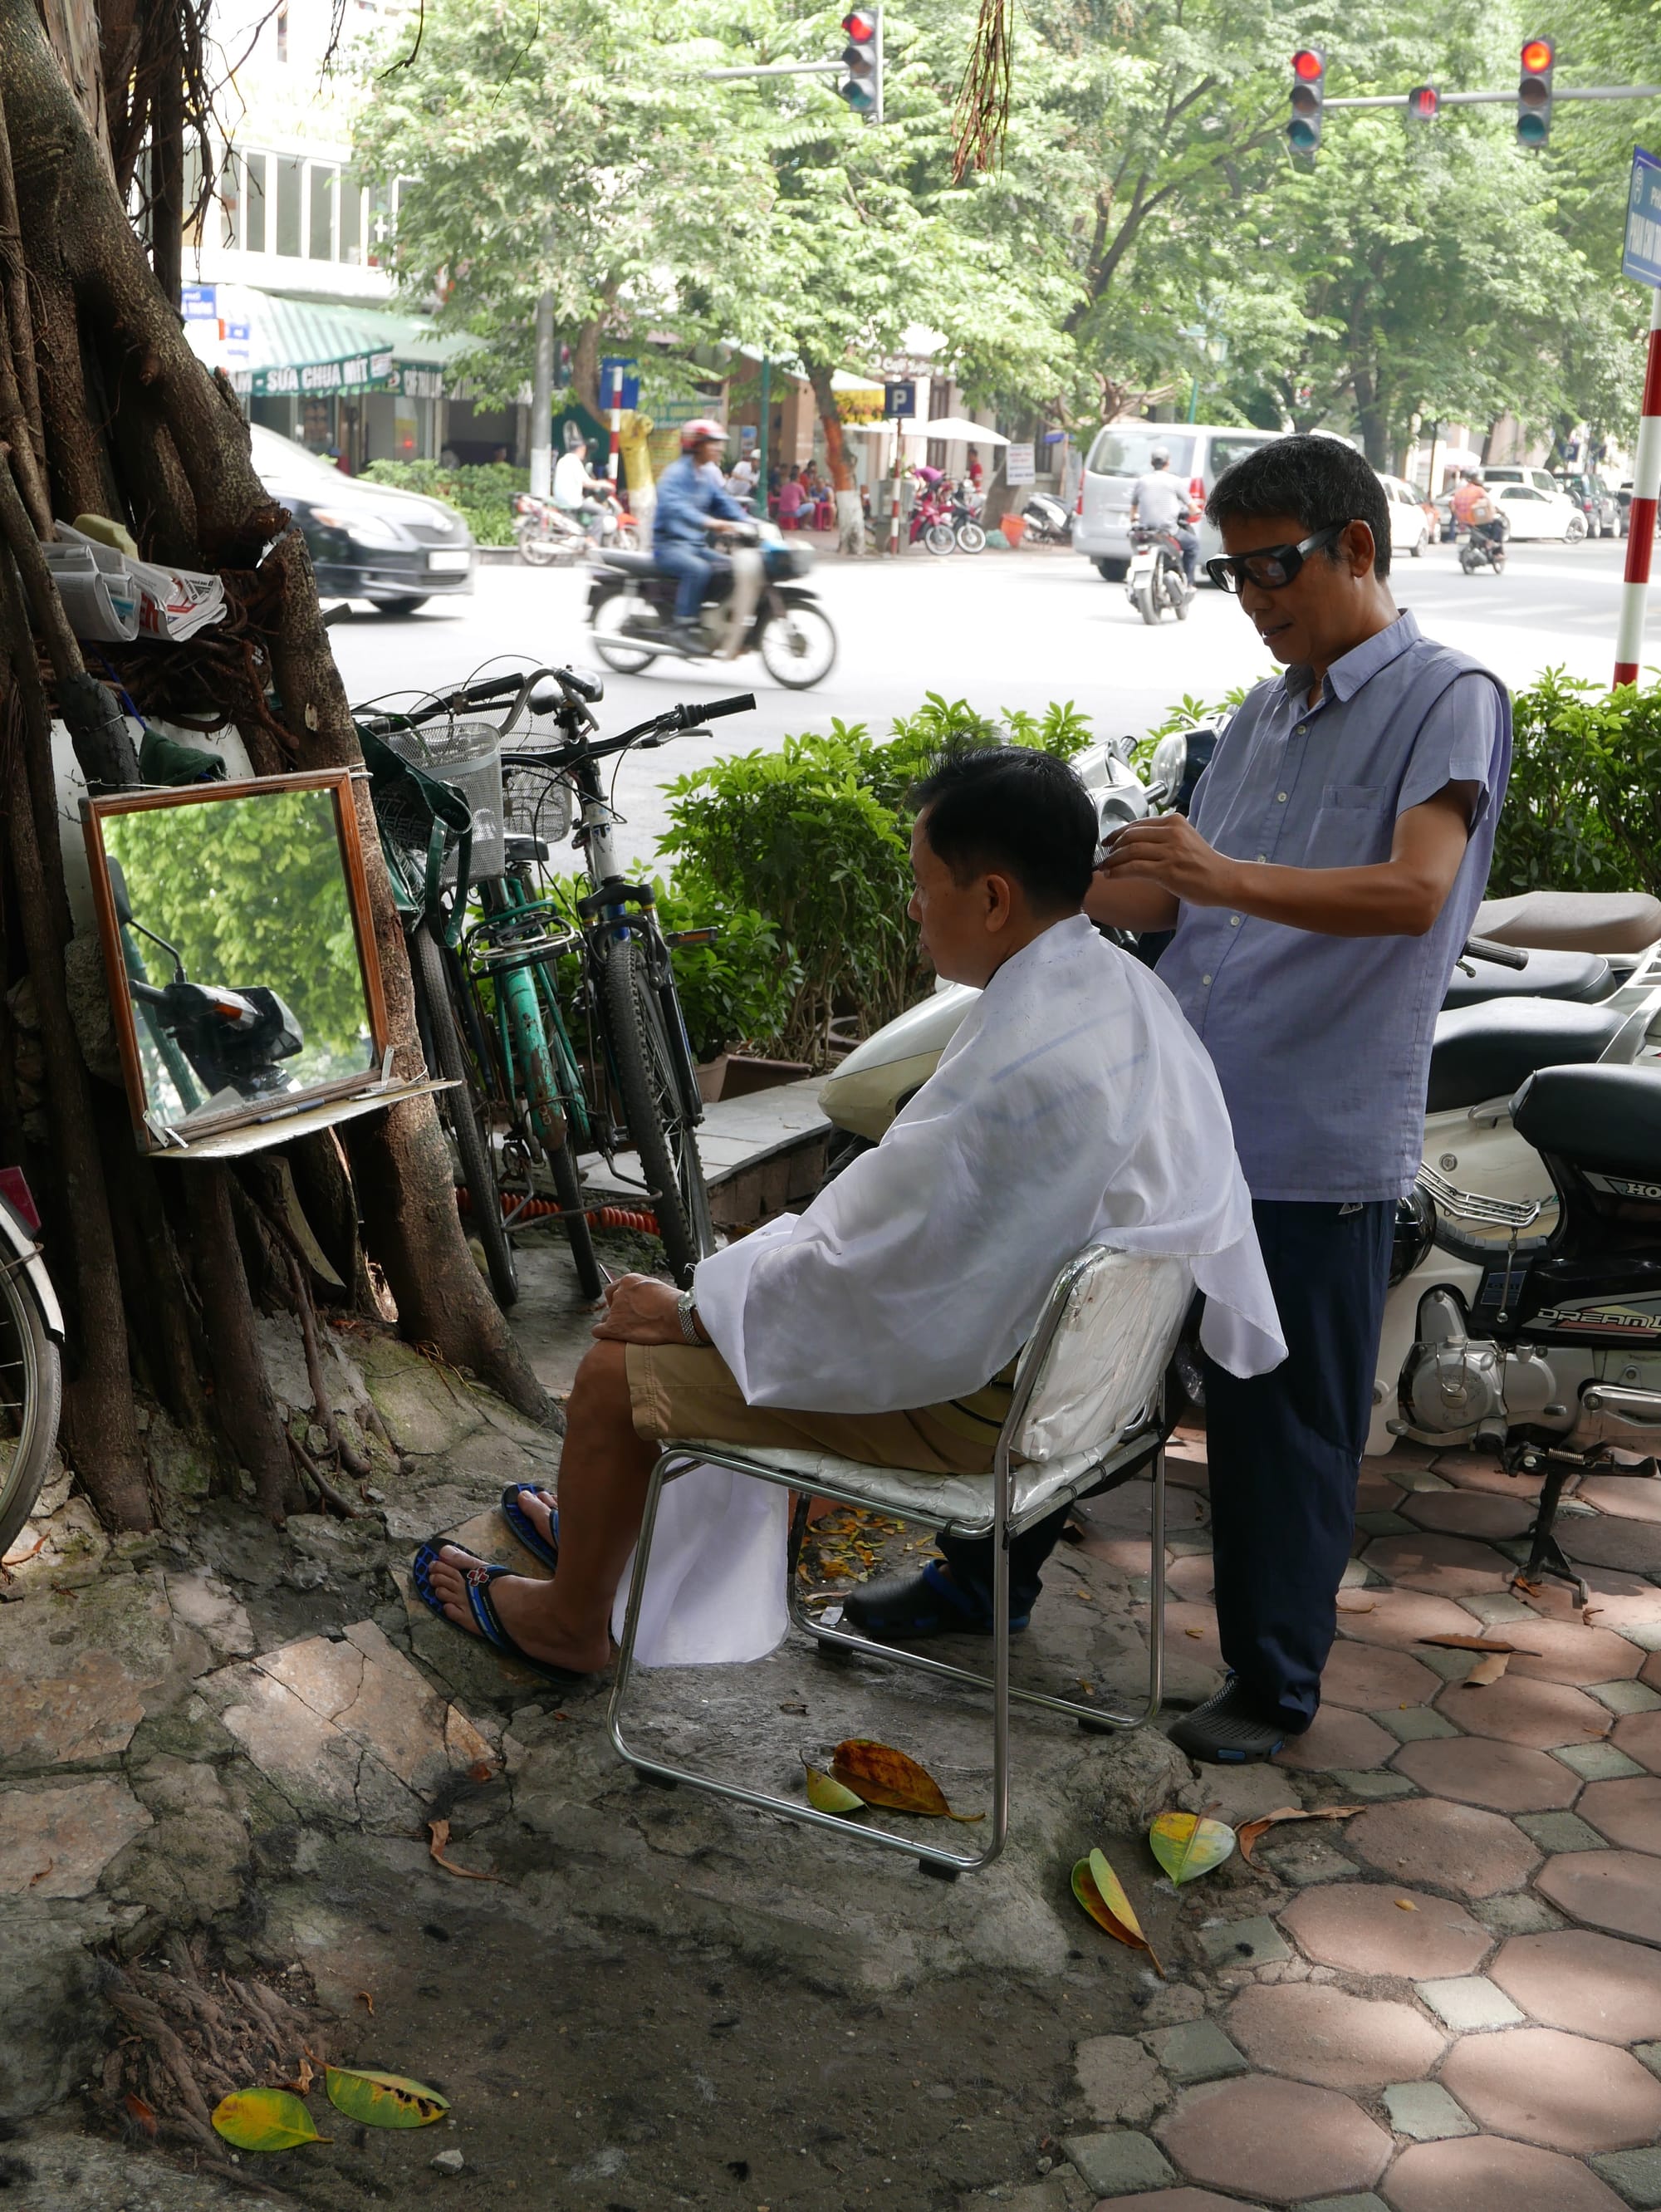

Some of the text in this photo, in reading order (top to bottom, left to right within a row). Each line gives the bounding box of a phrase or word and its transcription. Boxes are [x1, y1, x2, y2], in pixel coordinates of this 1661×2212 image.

[892, 390, 907, 411] P
[1565, 446, 1575, 458] P
[1538, 1308, 1649, 1327] DREAM
